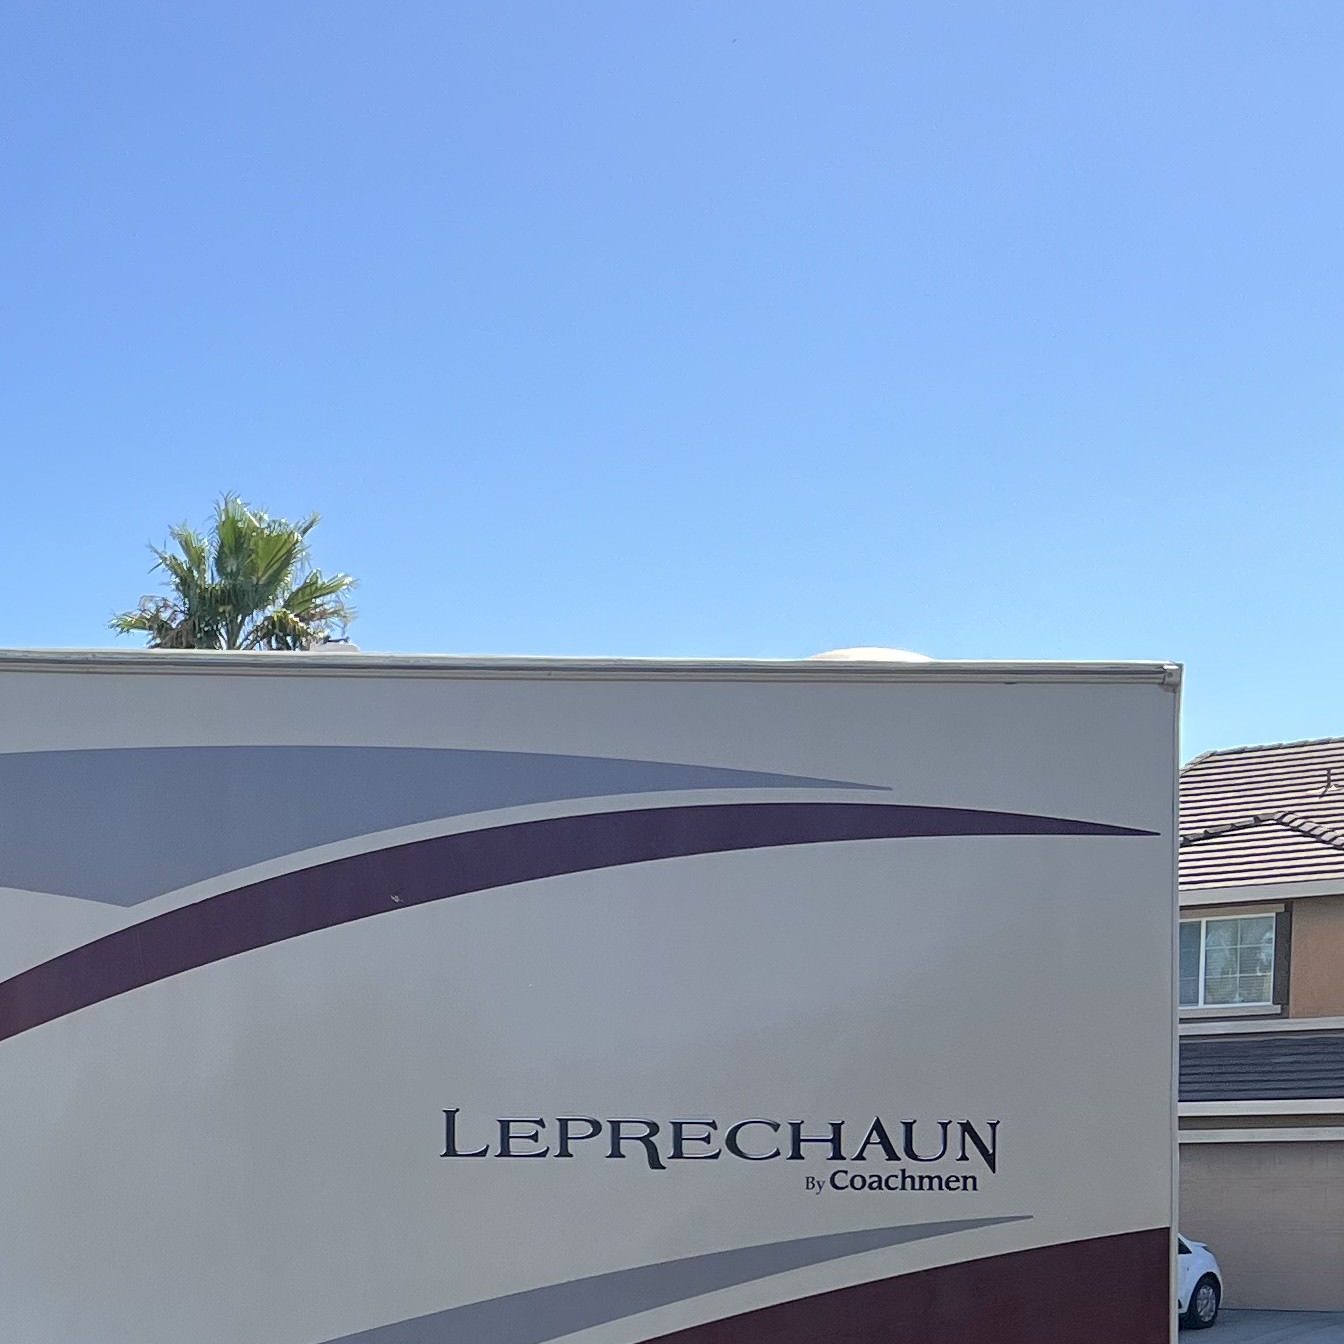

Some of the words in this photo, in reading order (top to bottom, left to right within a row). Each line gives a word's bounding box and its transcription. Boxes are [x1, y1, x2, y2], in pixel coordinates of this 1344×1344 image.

[439, 1108, 1001, 1174] LEPRECHAUN
[805, 1175, 825, 1195] By
[828, 1168, 979, 1193] Coachmen
